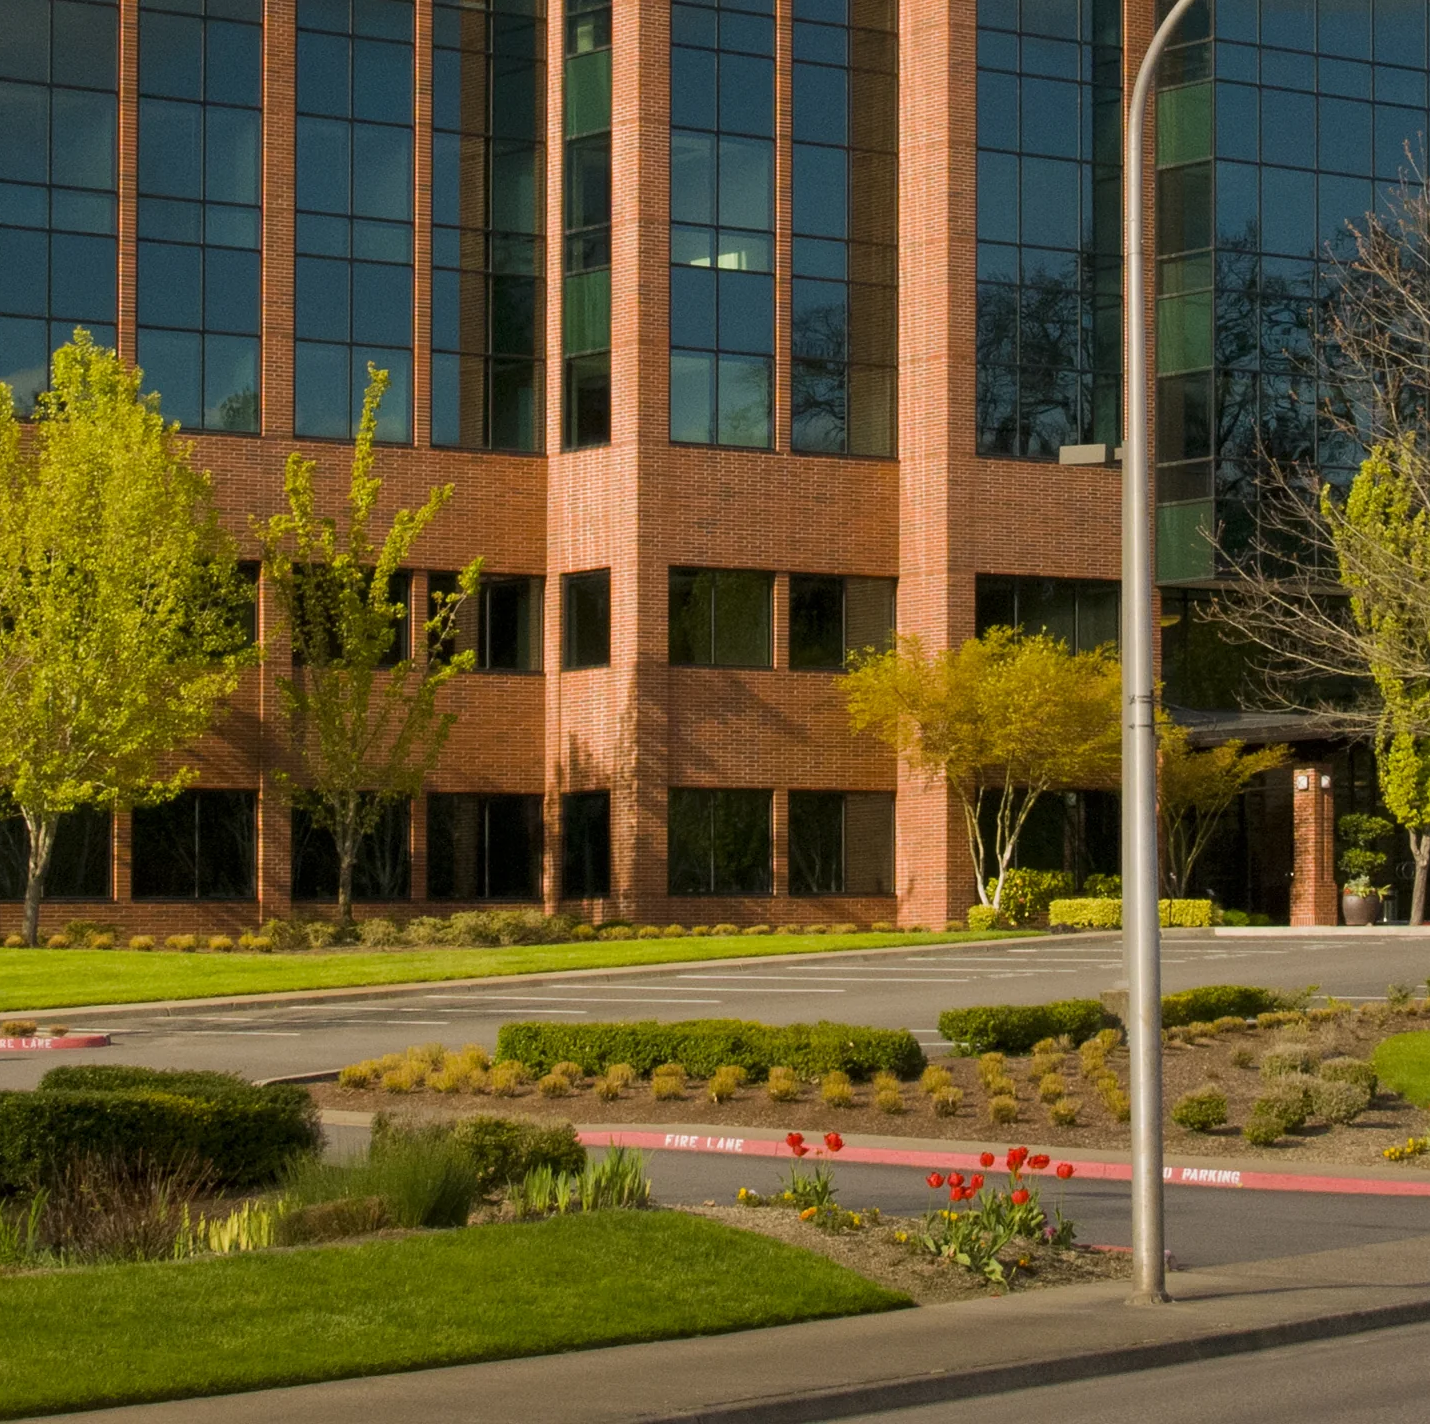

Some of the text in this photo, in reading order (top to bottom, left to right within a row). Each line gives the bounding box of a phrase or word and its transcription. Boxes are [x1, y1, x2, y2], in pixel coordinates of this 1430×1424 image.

[21, 1037, 52, 1049] LANE
[664, 1134, 744, 1152] FIRE LANE
[1163, 1166, 1241, 1184] O PARKING
